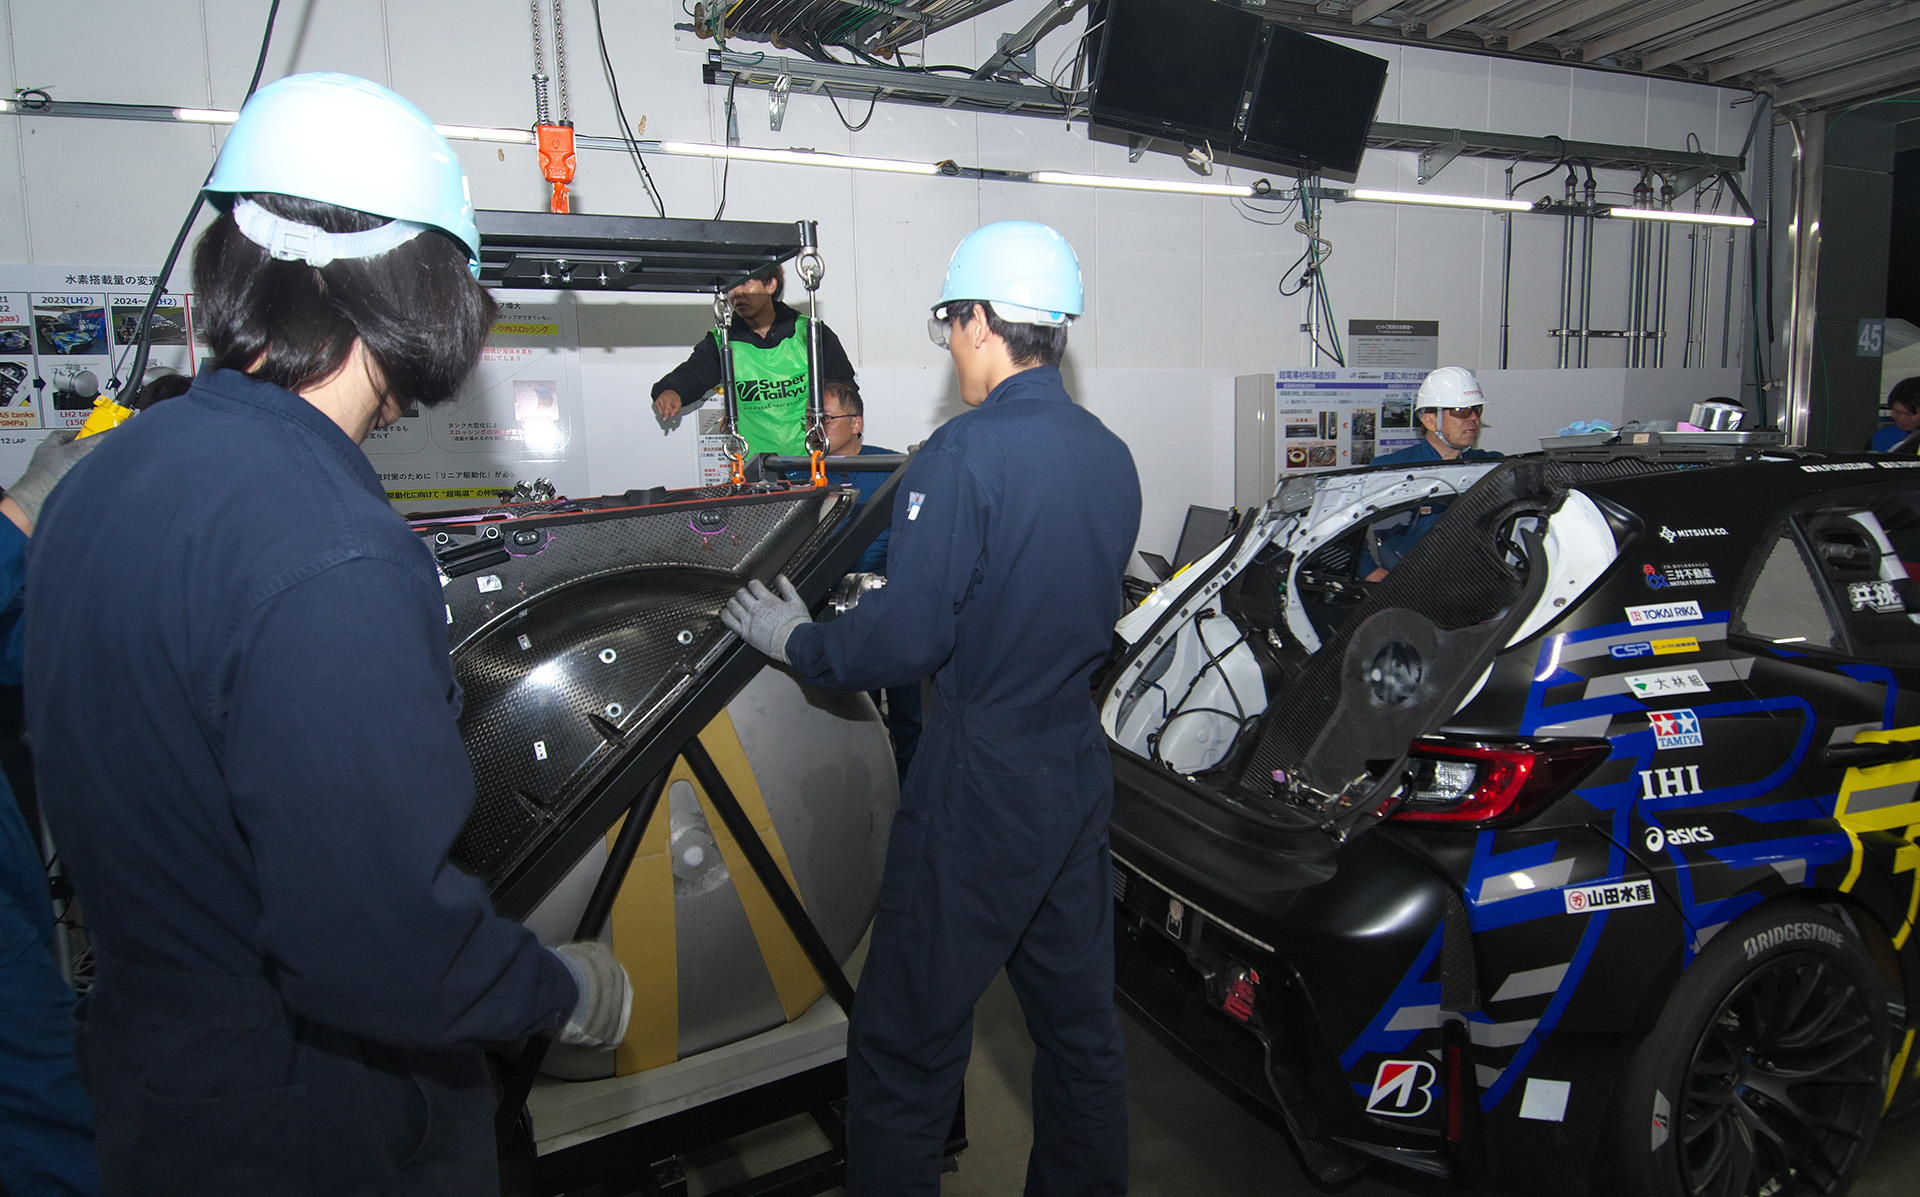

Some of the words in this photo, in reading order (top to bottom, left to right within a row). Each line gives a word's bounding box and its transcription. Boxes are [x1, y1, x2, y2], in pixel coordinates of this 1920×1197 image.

[41, 296, 94, 306] 2023(LH2)
[1859, 324, 1882, 352] 45
[760, 374, 805, 391] Super
[760, 386, 807, 401] Taikyu
[0, 419, 28, 428] 0MPa)
[1665, 567, 1714, 581] 三井不動産
[1642, 607, 1675, 620] TOKAI
[1674, 605, 1699, 617] RIKA
[1611, 642, 1651, 658] CSP
[1654, 674, 1704, 691] 大林組
[1658, 734, 1701, 748] TAMIYA
[1638, 764, 1704, 801] IHI
[1665, 825, 1716, 846] asics
[1587, 884, 1653, 908] 山田水産
[1743, 922, 1845, 961] BRIDGESTONE
